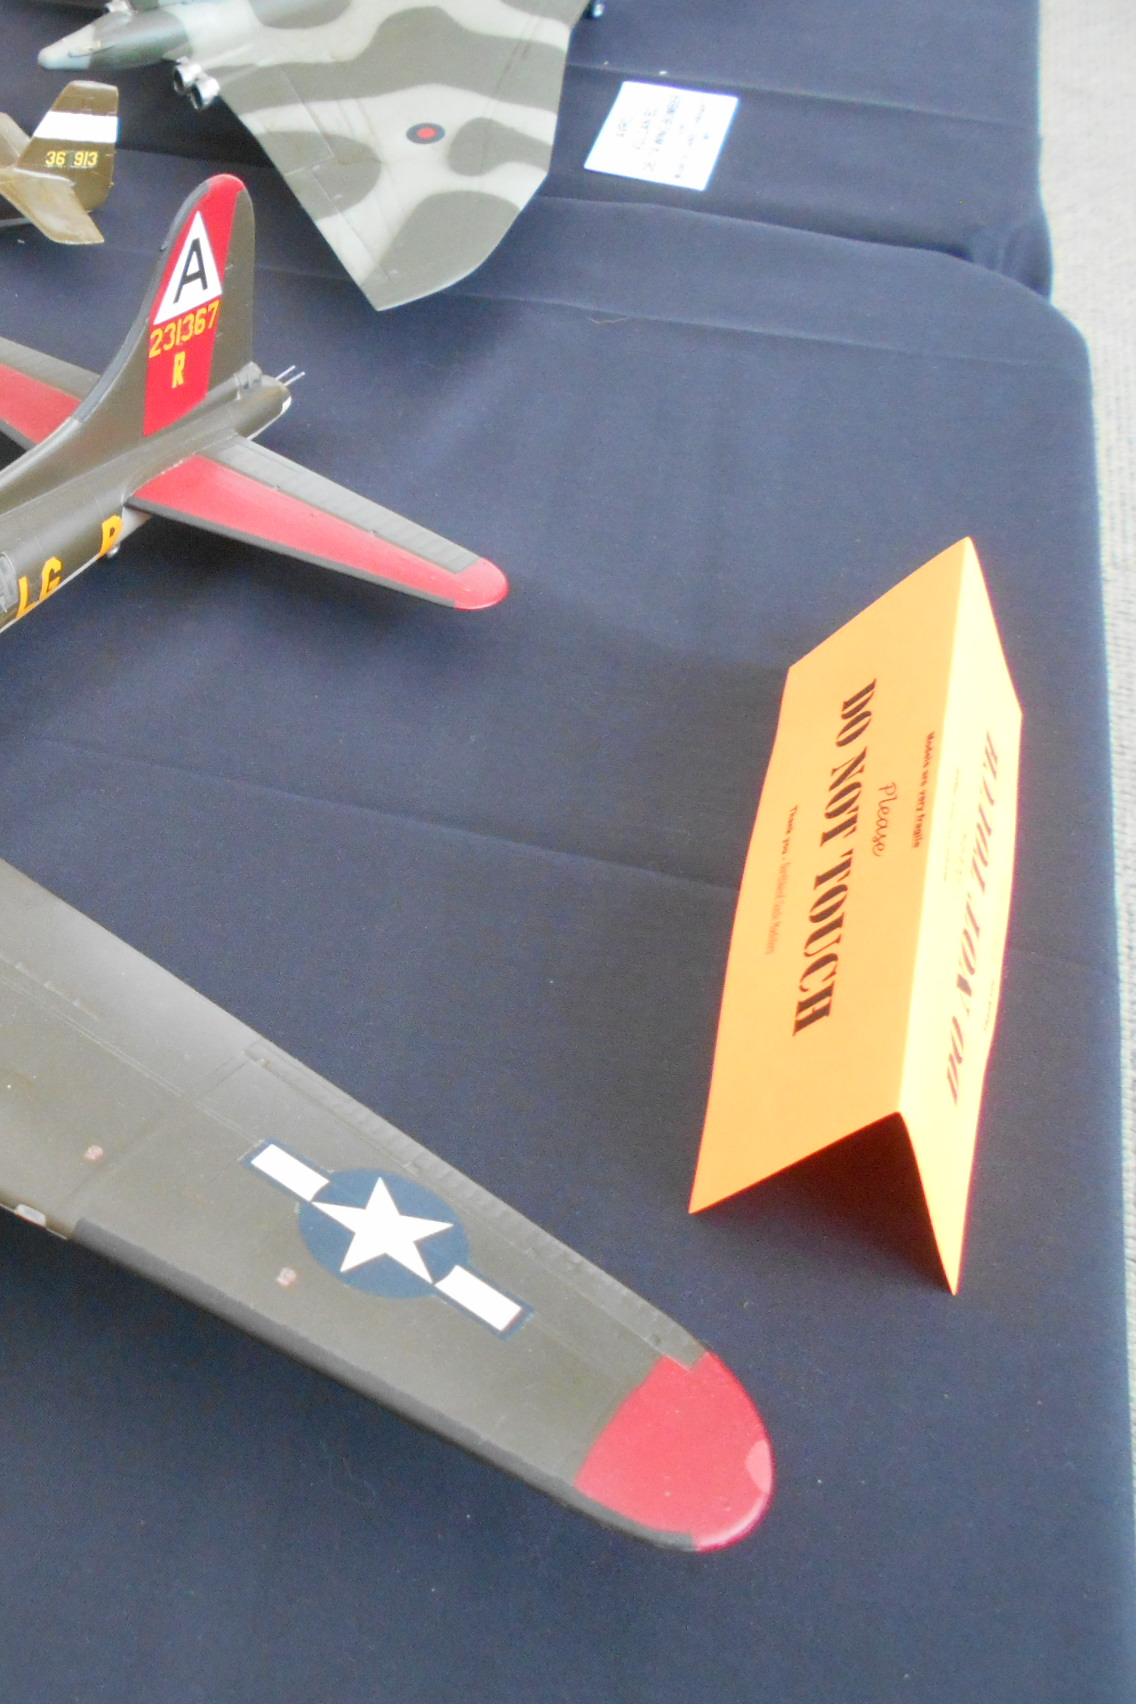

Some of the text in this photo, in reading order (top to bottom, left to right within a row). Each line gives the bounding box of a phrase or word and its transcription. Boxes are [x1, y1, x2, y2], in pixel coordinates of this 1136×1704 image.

[45, 151, 98, 167] 36 913
[173, 237, 208, 304] A
[149, 300, 220, 358] 231367
[172, 351, 186, 388] R
[872, 782, 897, 857] Please
[916, 789, 926, 811] very
[913, 813, 925, 848] fragile
[792, 678, 876, 1037] DO NOT TOUCH
